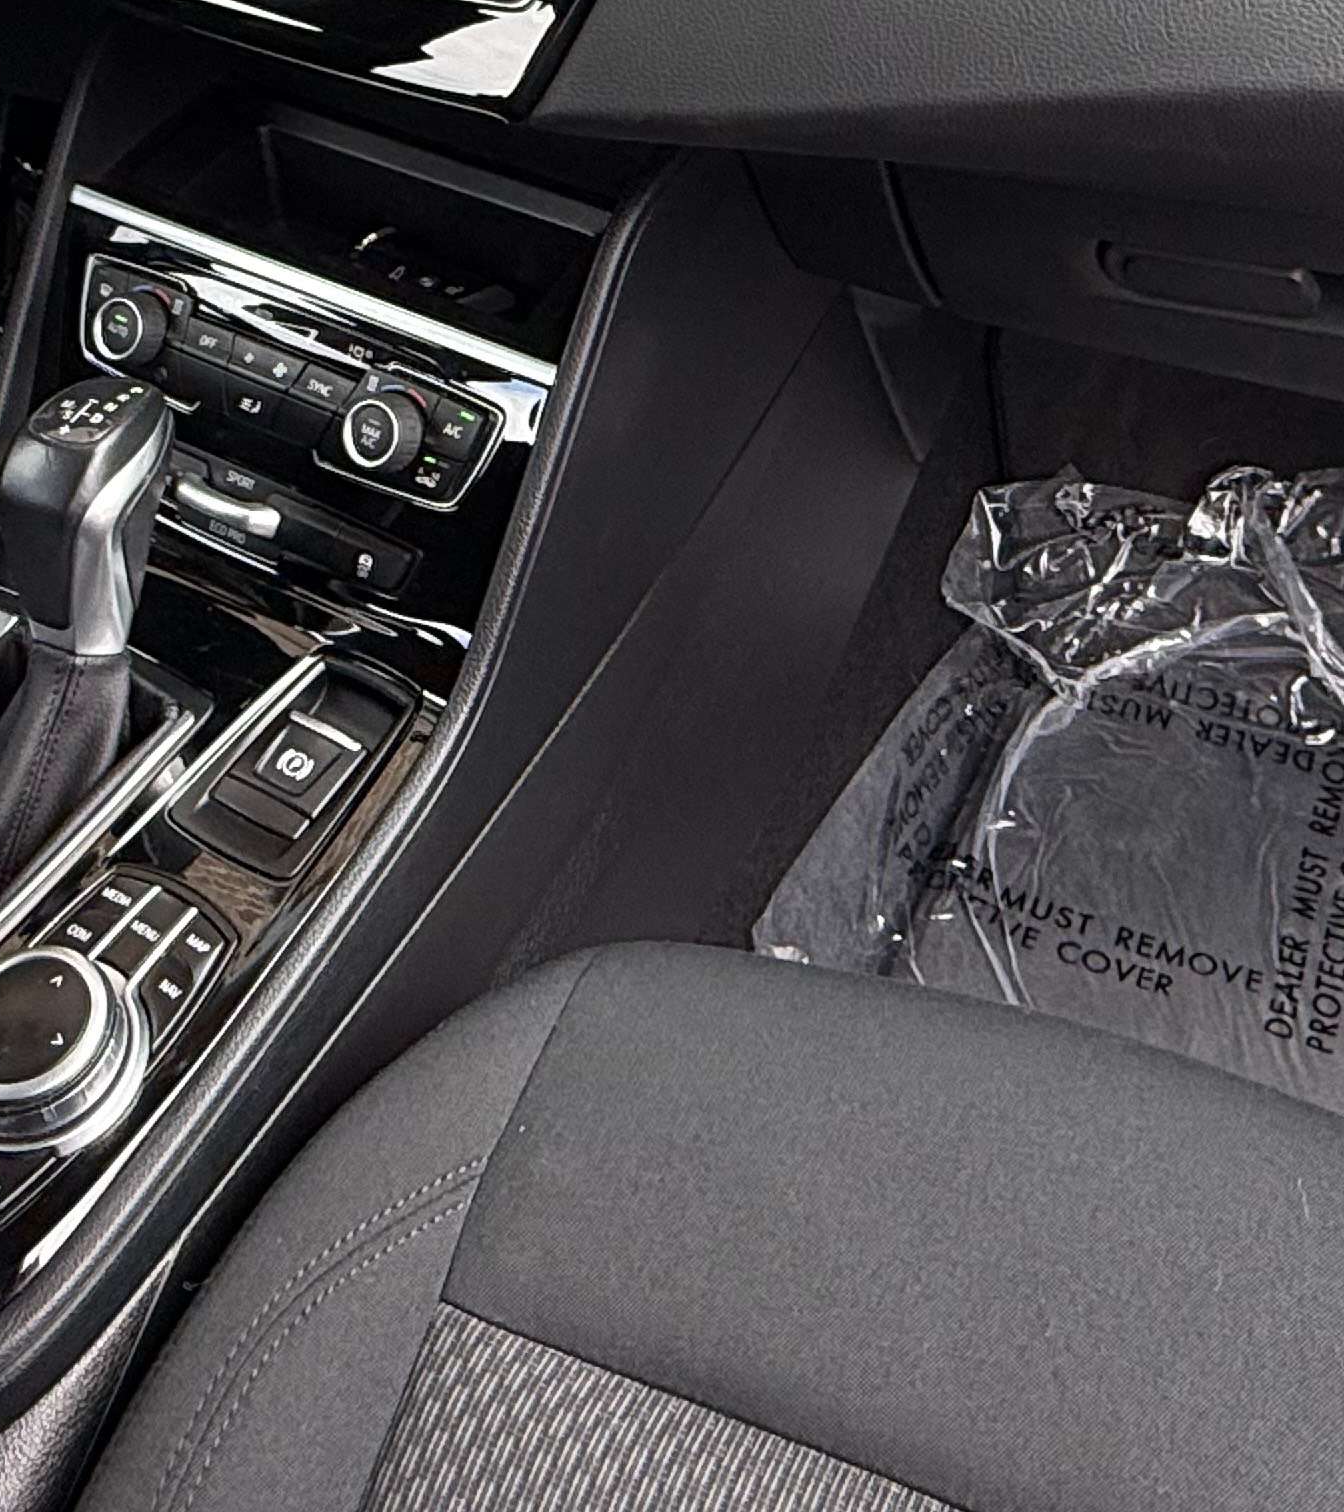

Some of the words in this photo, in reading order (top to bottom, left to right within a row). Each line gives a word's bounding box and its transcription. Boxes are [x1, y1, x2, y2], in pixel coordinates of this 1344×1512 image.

[198, 335, 218, 349] OFF
[307, 378, 334, 398] SYNC
[442, 422, 464, 439] A/C
[225, 469, 256, 491] SPORT
[208, 519, 227, 535] ECO
[227, 525, 247, 545] PRO
[1195, 717, 1316, 774] DEALER
[101, 886, 133, 908] MEDIA
[66, 923, 94, 943] COM
[130, 919, 161, 943] MENU
[1000, 886, 1096, 936] MUST
[1114, 925, 1265, 994] REMOVE
[185, 932, 213, 954] MAP
[1265, 934, 1310, 1040] DEALER
[1293, 847, 1330, 920] MUST
[1057, 941, 1175, 996] COVER
[158, 977, 184, 1001] NAV
